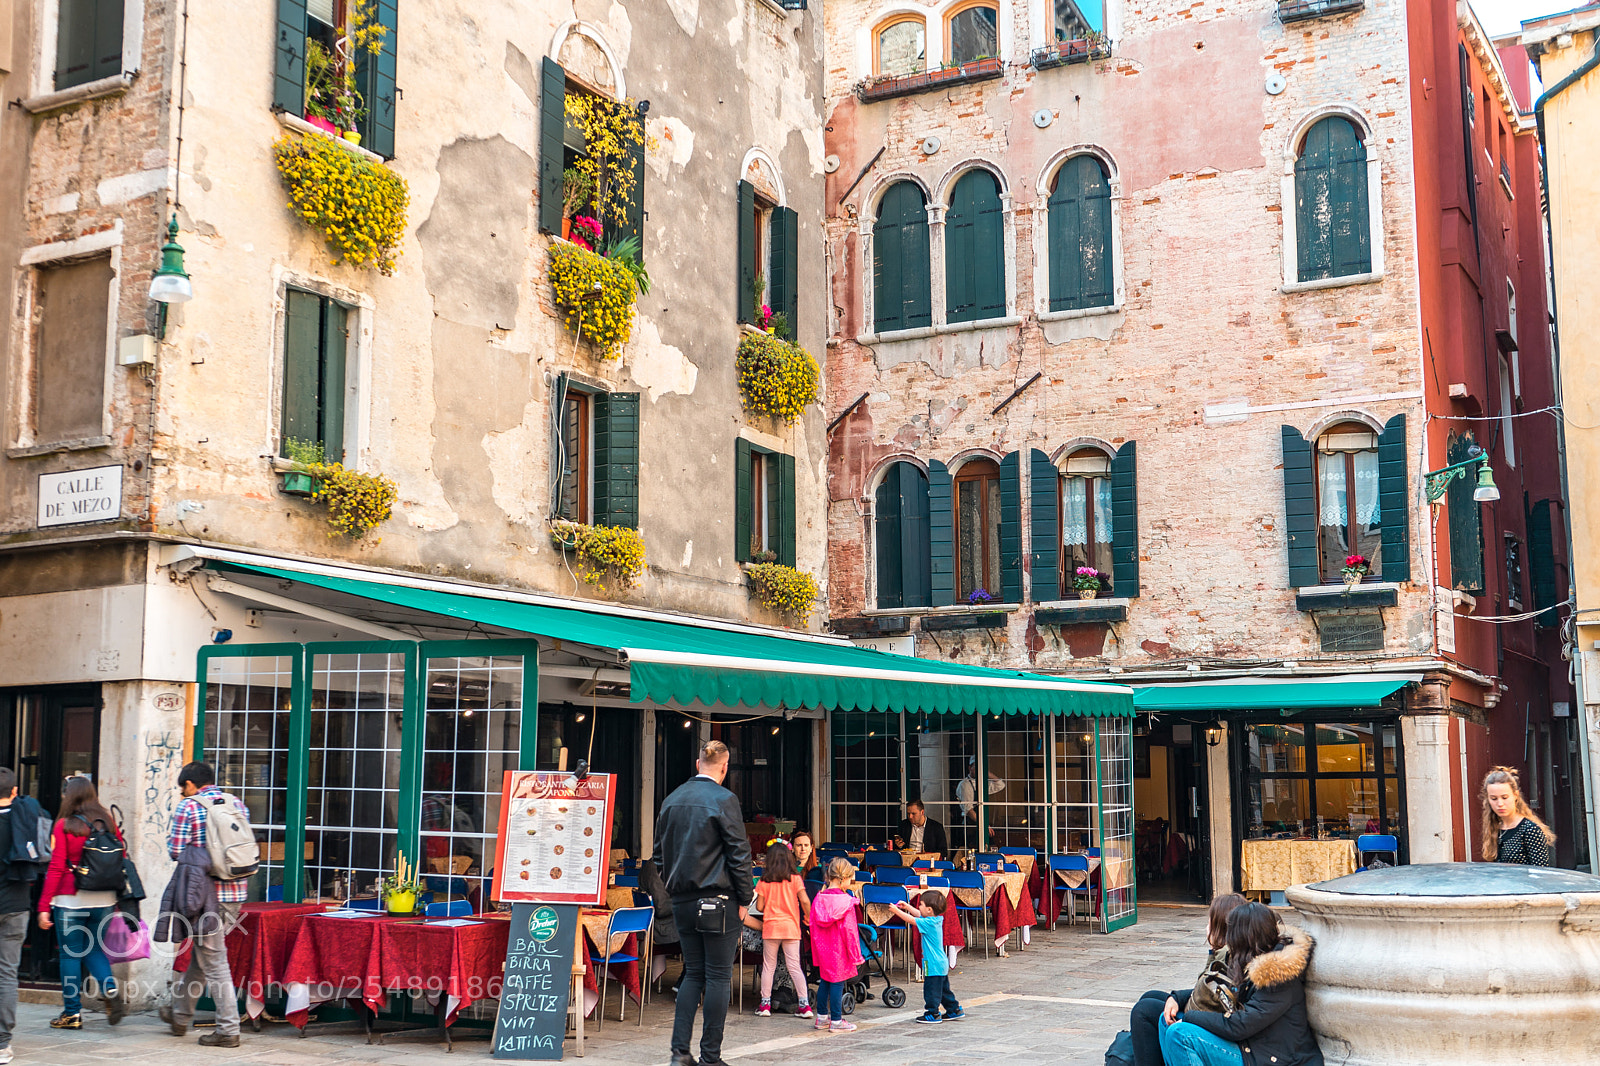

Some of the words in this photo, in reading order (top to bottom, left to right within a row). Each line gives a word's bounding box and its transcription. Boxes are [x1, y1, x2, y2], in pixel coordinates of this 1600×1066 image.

[57, 476, 105, 495] CALLE
[45, 502, 65, 518] DE
[71, 496, 112, 515] MEZO
[574, 781, 605, 789] ZZARIA
[530, 918, 558, 931] Dreher
[515, 938, 558, 953] BAR
[509, 955, 551, 971] BIRRA
[506, 974, 553, 990] CAFFE
